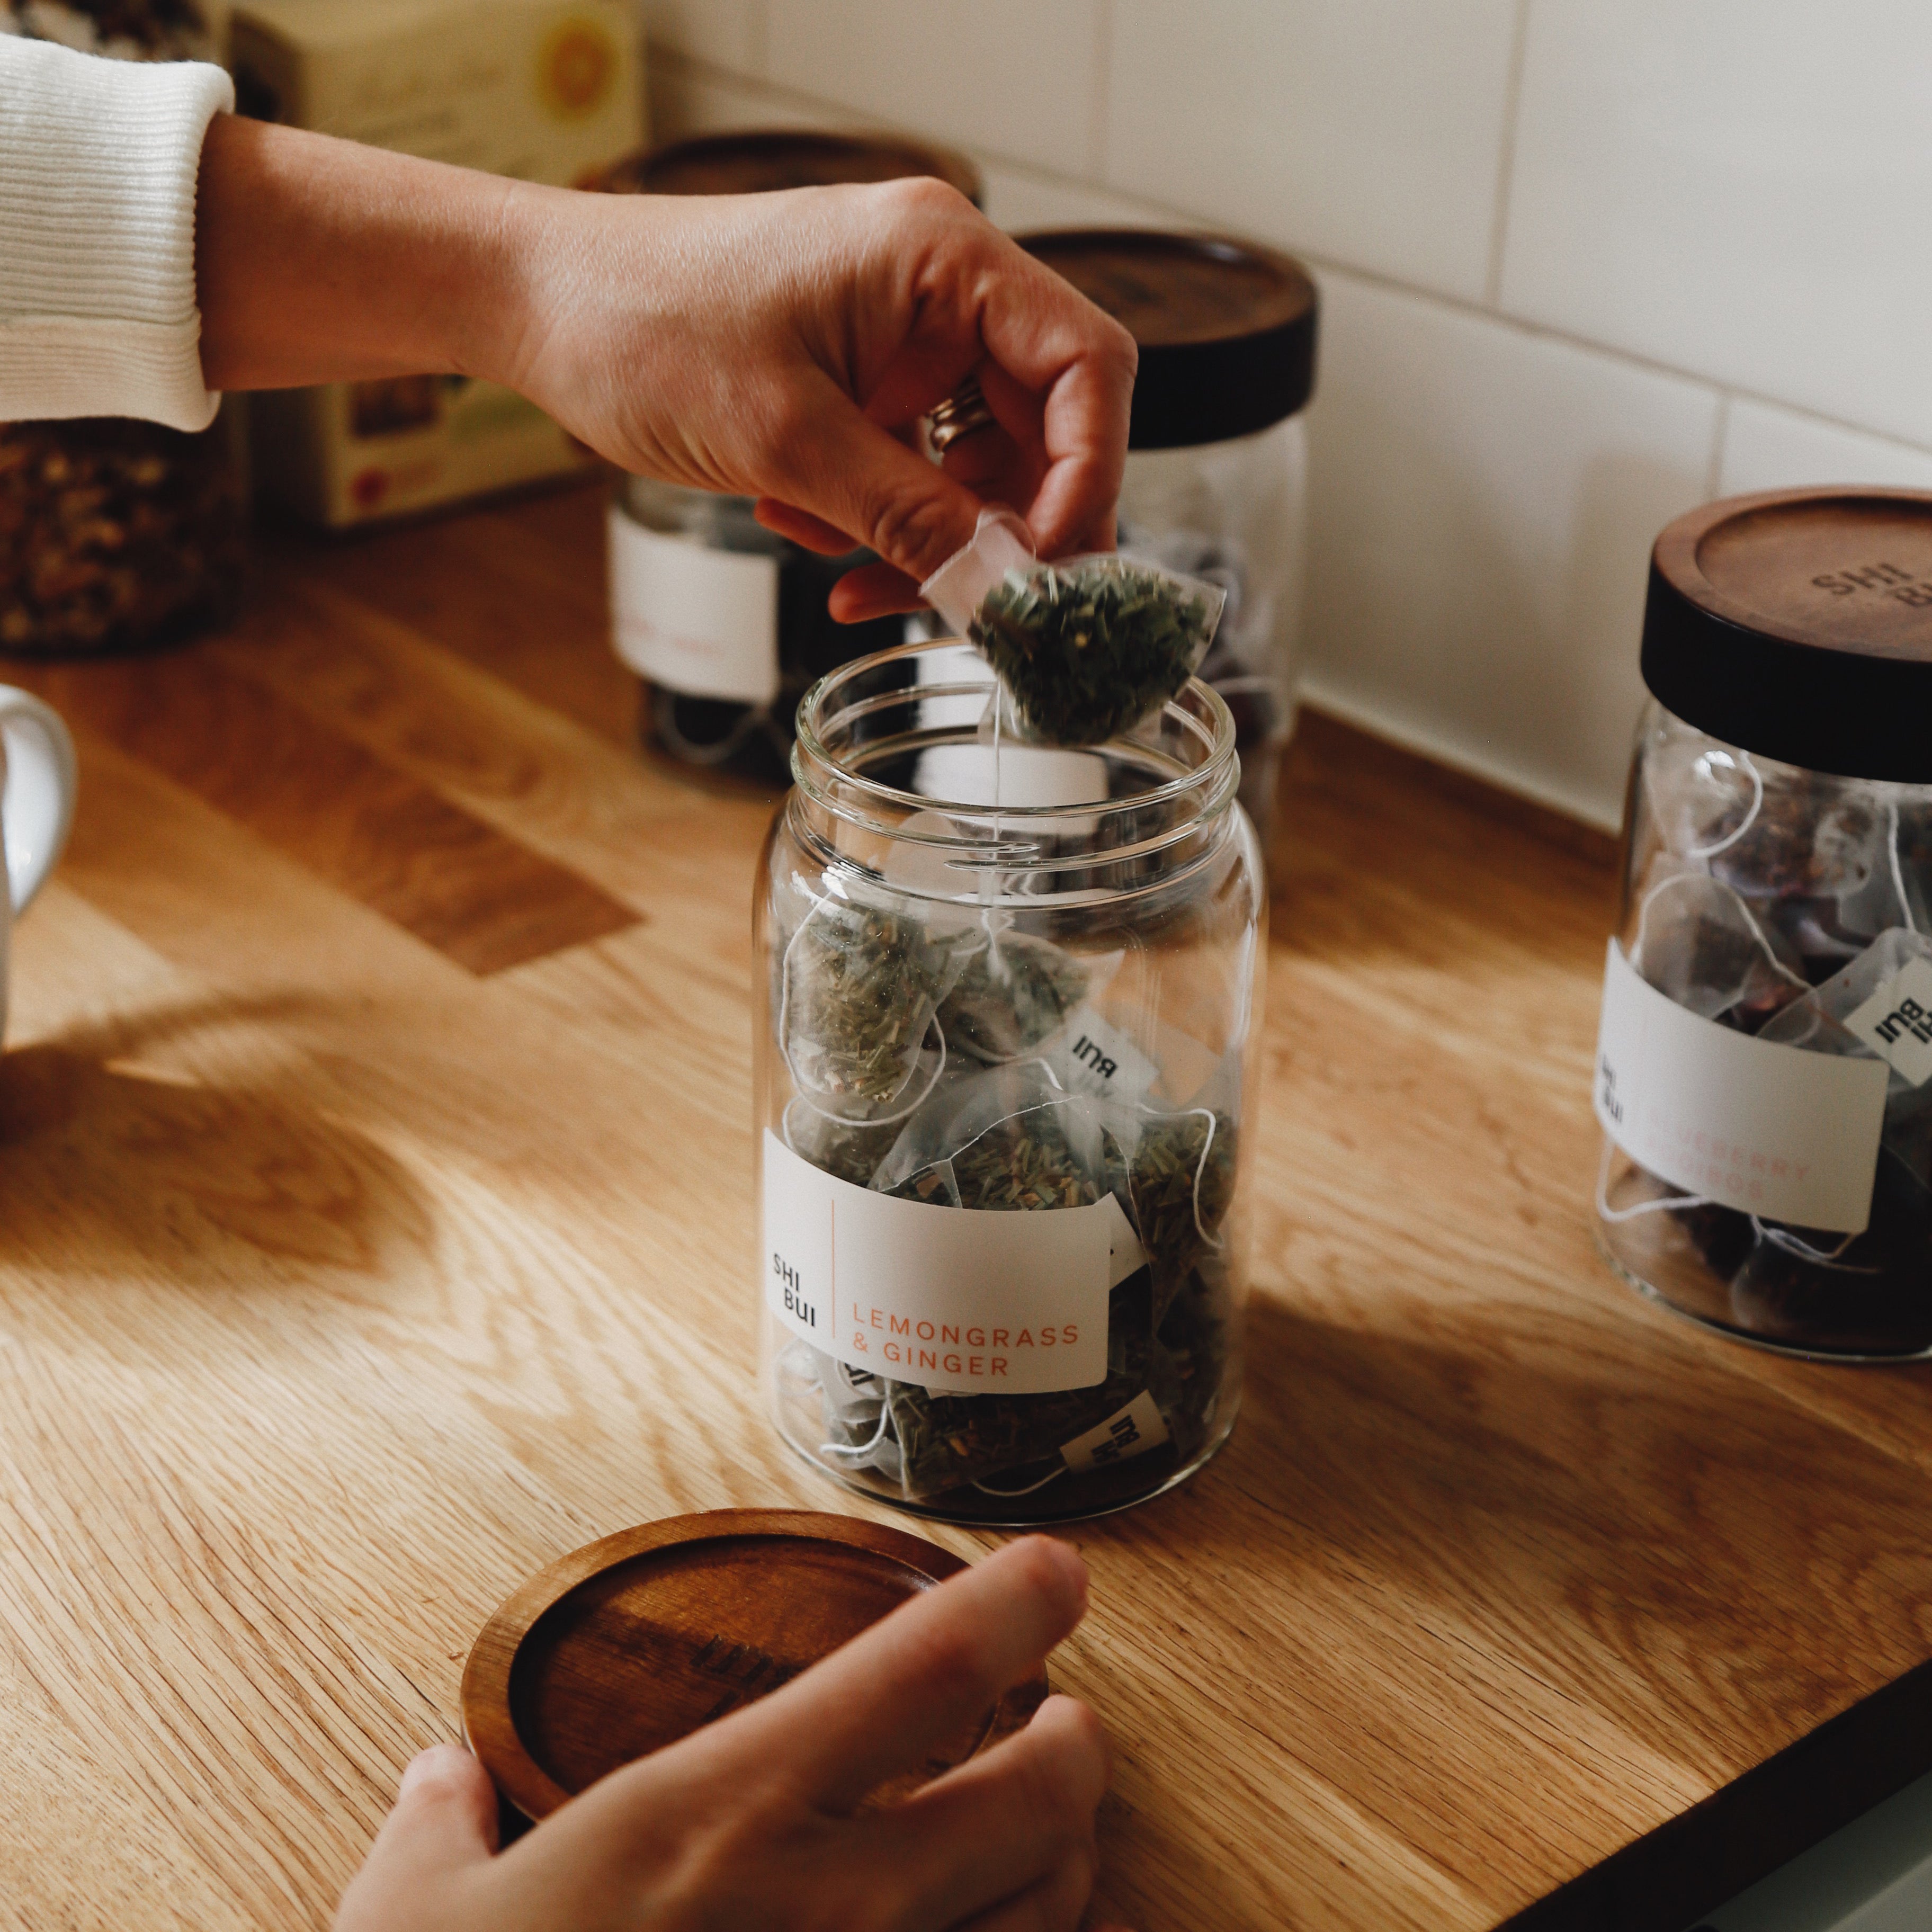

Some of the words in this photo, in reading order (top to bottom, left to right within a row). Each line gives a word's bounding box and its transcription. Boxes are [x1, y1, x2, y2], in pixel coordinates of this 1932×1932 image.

[1812, 562, 1914, 596] SHI
[1875, 998, 1924, 1043] BUI
[774, 1253, 799, 1292] SHI
[784, 1286, 815, 1327] BUI
[853, 1302, 1078, 1348] LEMONGRASS
[853, 1331, 868, 1353] &
[883, 1341, 1007, 1376] GINGER
